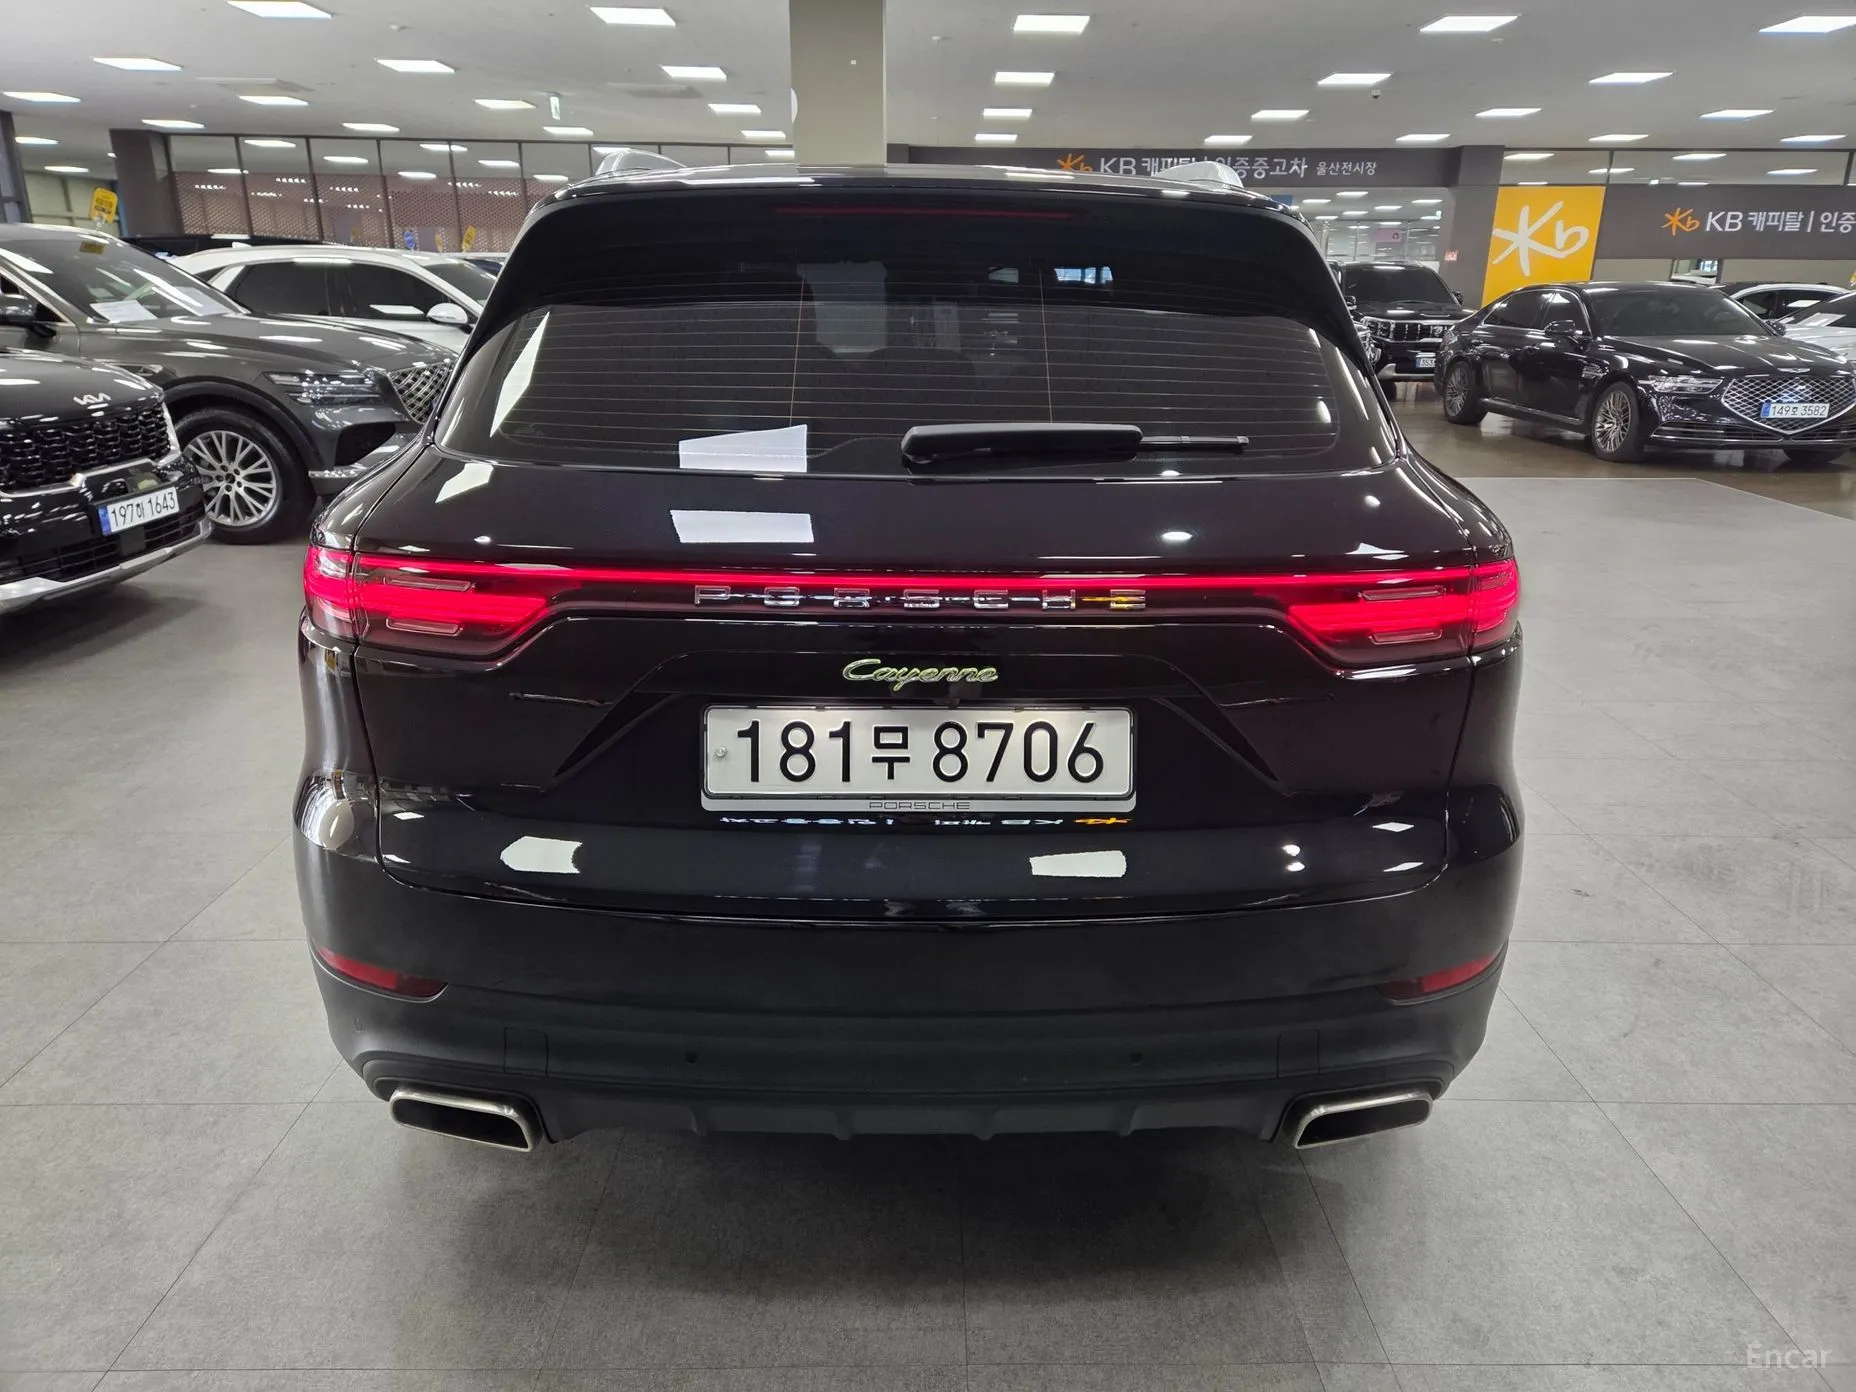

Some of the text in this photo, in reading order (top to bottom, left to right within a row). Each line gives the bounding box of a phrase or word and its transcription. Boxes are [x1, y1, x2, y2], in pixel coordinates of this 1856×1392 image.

[1100, 157, 1136, 177] KB
[1316, 161, 1378, 176] 울산전시장
[1705, 211, 1743, 232] KB
[1748, 211, 1803, 232] 캐피탈
[1801, 405, 1827, 416] 3582
[148, 491, 176, 515] 1643
[694, 585, 1146, 610] PORSCHE
[842, 658, 998, 691] Cayenne
[932, 720, 1104, 783] 8706
[868, 801, 971, 811] PORSCHE
